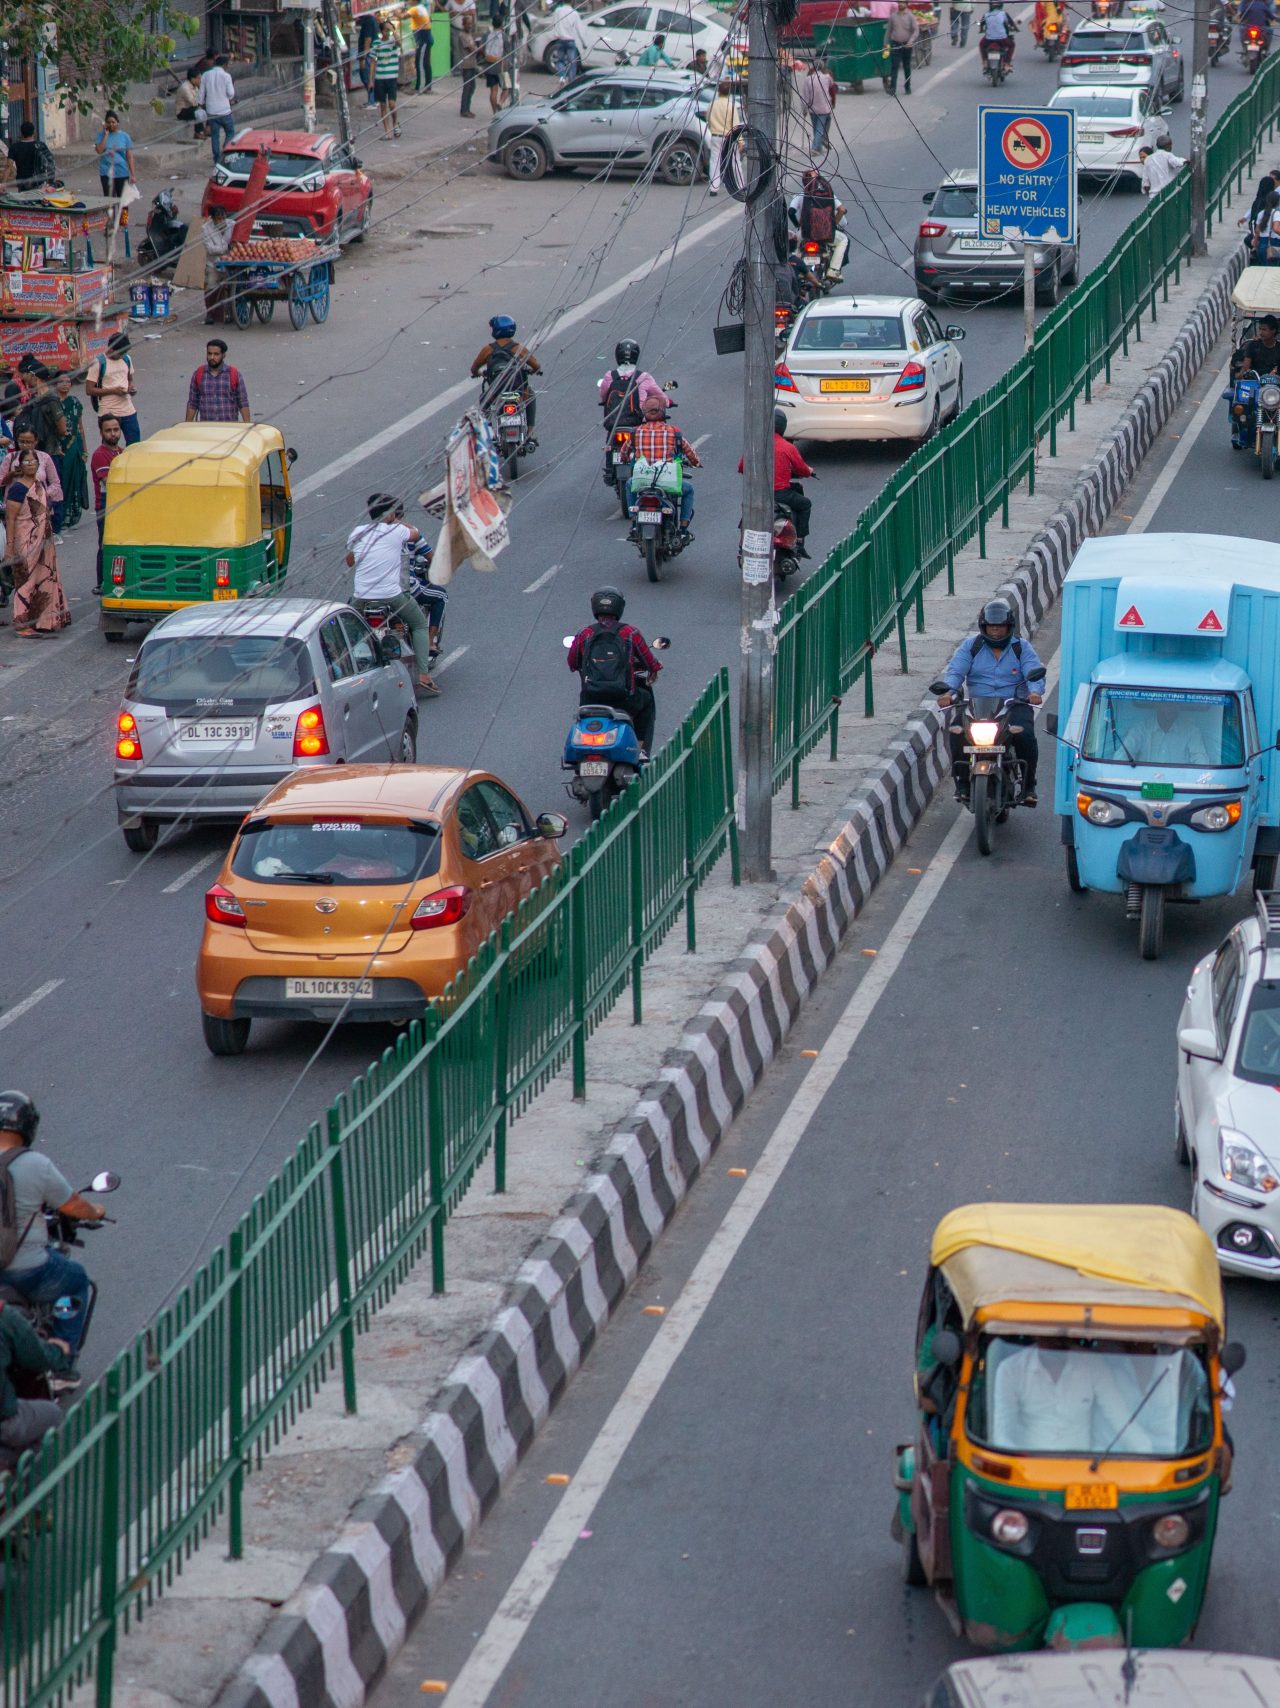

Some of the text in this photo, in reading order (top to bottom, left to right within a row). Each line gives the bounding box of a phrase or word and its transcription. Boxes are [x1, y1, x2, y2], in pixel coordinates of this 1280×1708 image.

[1000, 174, 1053, 186] NO ENTRY
[1015, 190, 1037, 201] FOR
[987, 205, 1066, 218] HEAVY VEHICLES
[1141, 691, 1185, 699] MARKETING
[1187, 693, 1223, 701] SERVICES
[188, 726, 200, 738] DL
[204, 727, 222, 738] 13C
